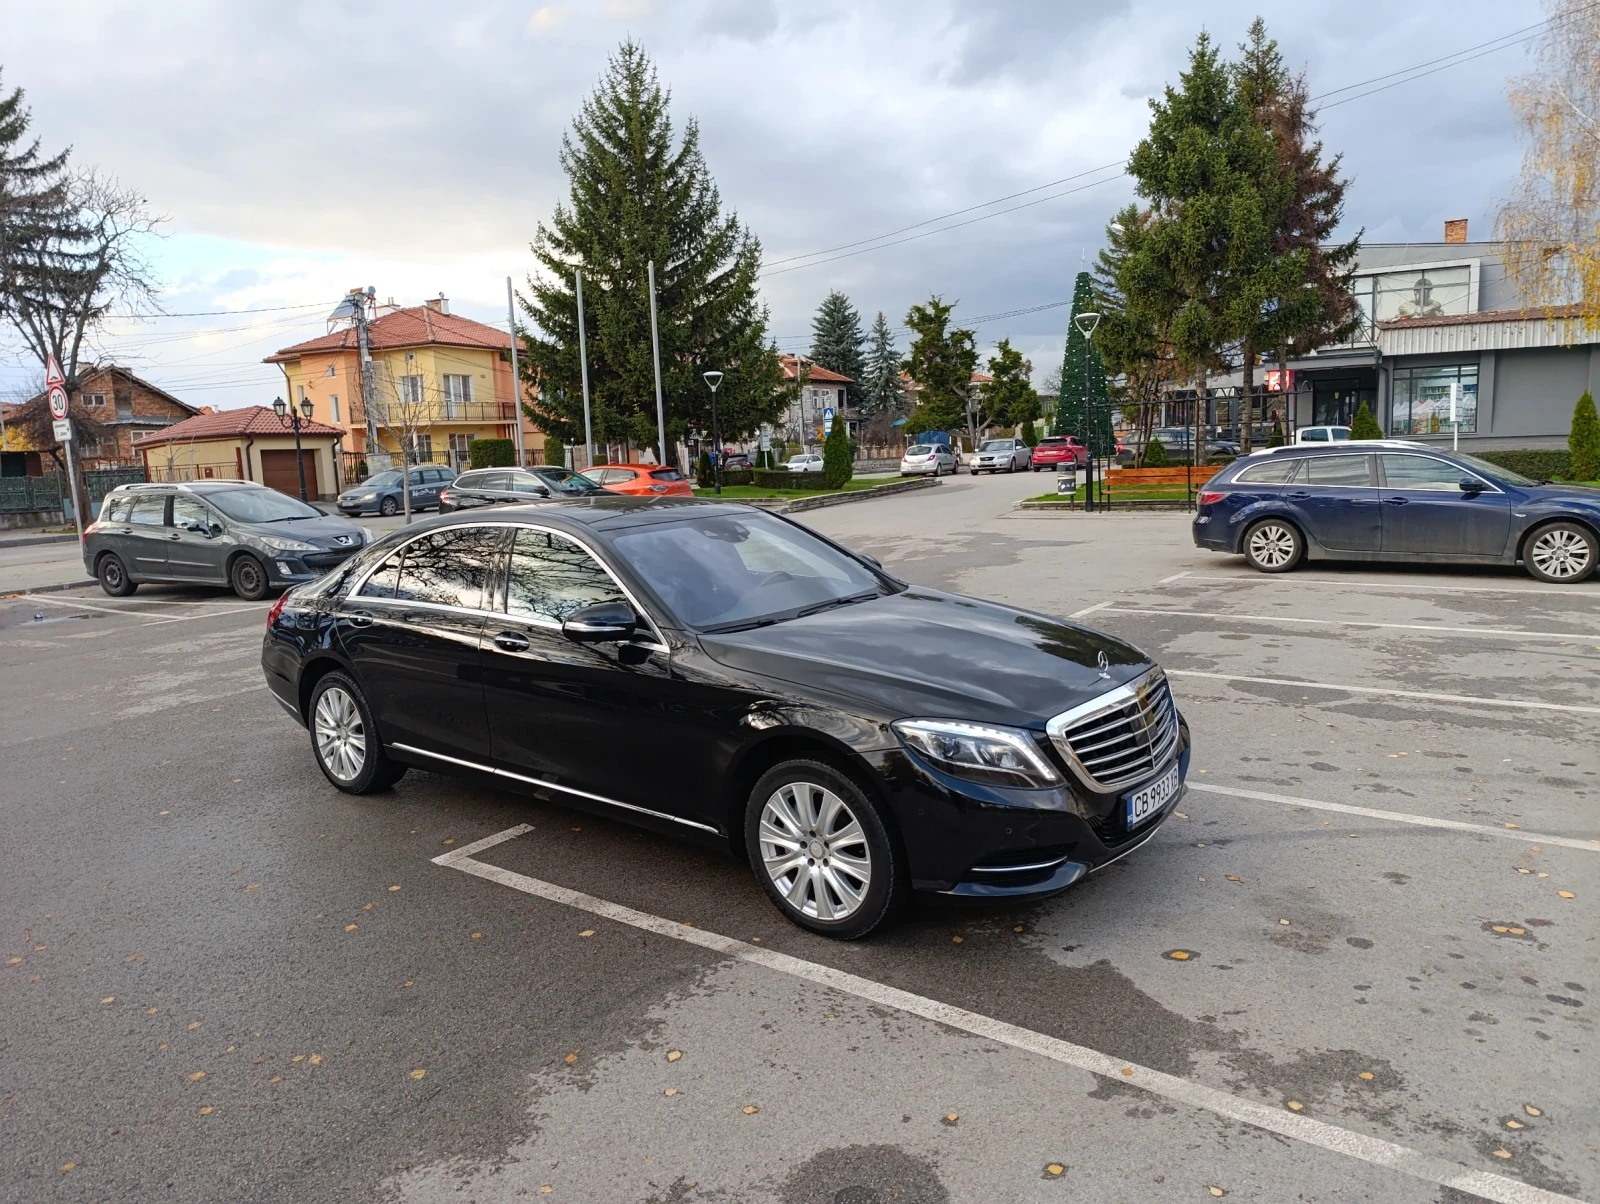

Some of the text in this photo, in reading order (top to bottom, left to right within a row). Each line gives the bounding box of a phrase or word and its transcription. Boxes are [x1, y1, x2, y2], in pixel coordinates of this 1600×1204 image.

[52, 394, 63, 410] 30
[1135, 792, 1149, 817] CB
[1151, 776, 1169, 808] 9933
